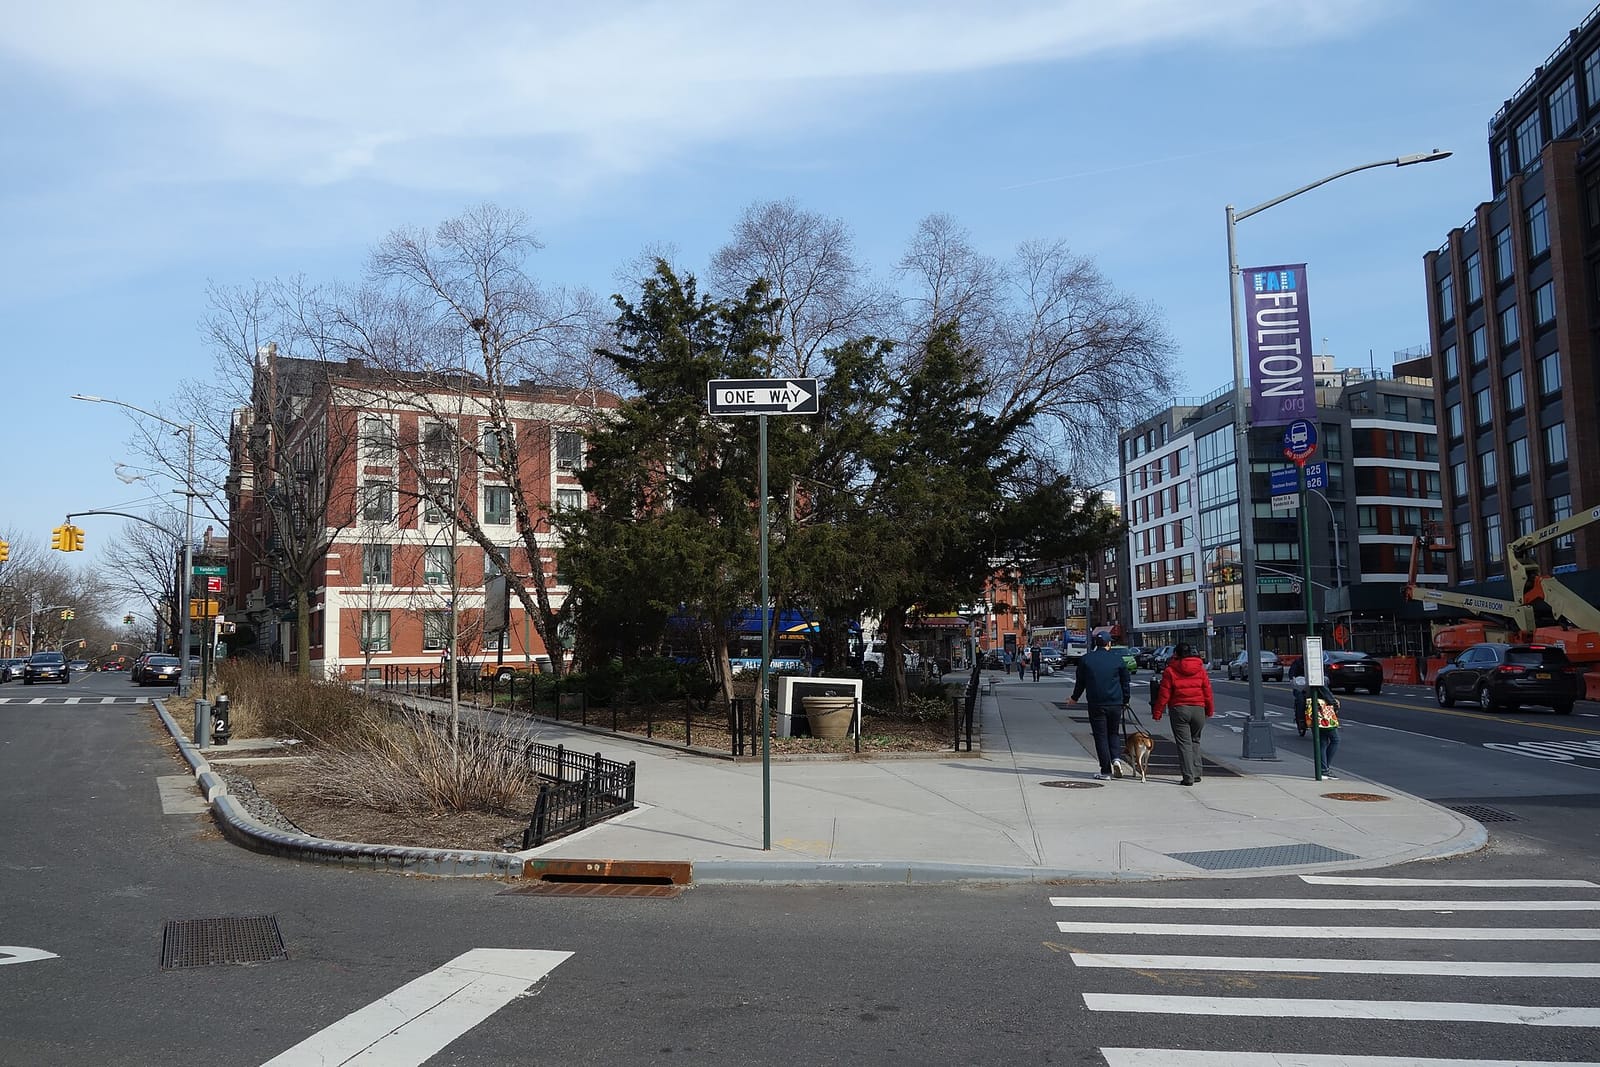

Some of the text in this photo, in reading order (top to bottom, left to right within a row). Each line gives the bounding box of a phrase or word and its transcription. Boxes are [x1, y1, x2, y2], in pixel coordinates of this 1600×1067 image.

[1254, 270, 1296, 291] FAB
[1255, 292, 1304, 397] FULTON
[724, 389, 801, 403] ONE WAY
[1281, 396, 1305, 412] .org
[1306, 464, 1321, 475] B25
[1306, 477, 1322, 488] B26
[1463, 598, 1473, 606] JLG
[216, 720, 225, 731] 2
